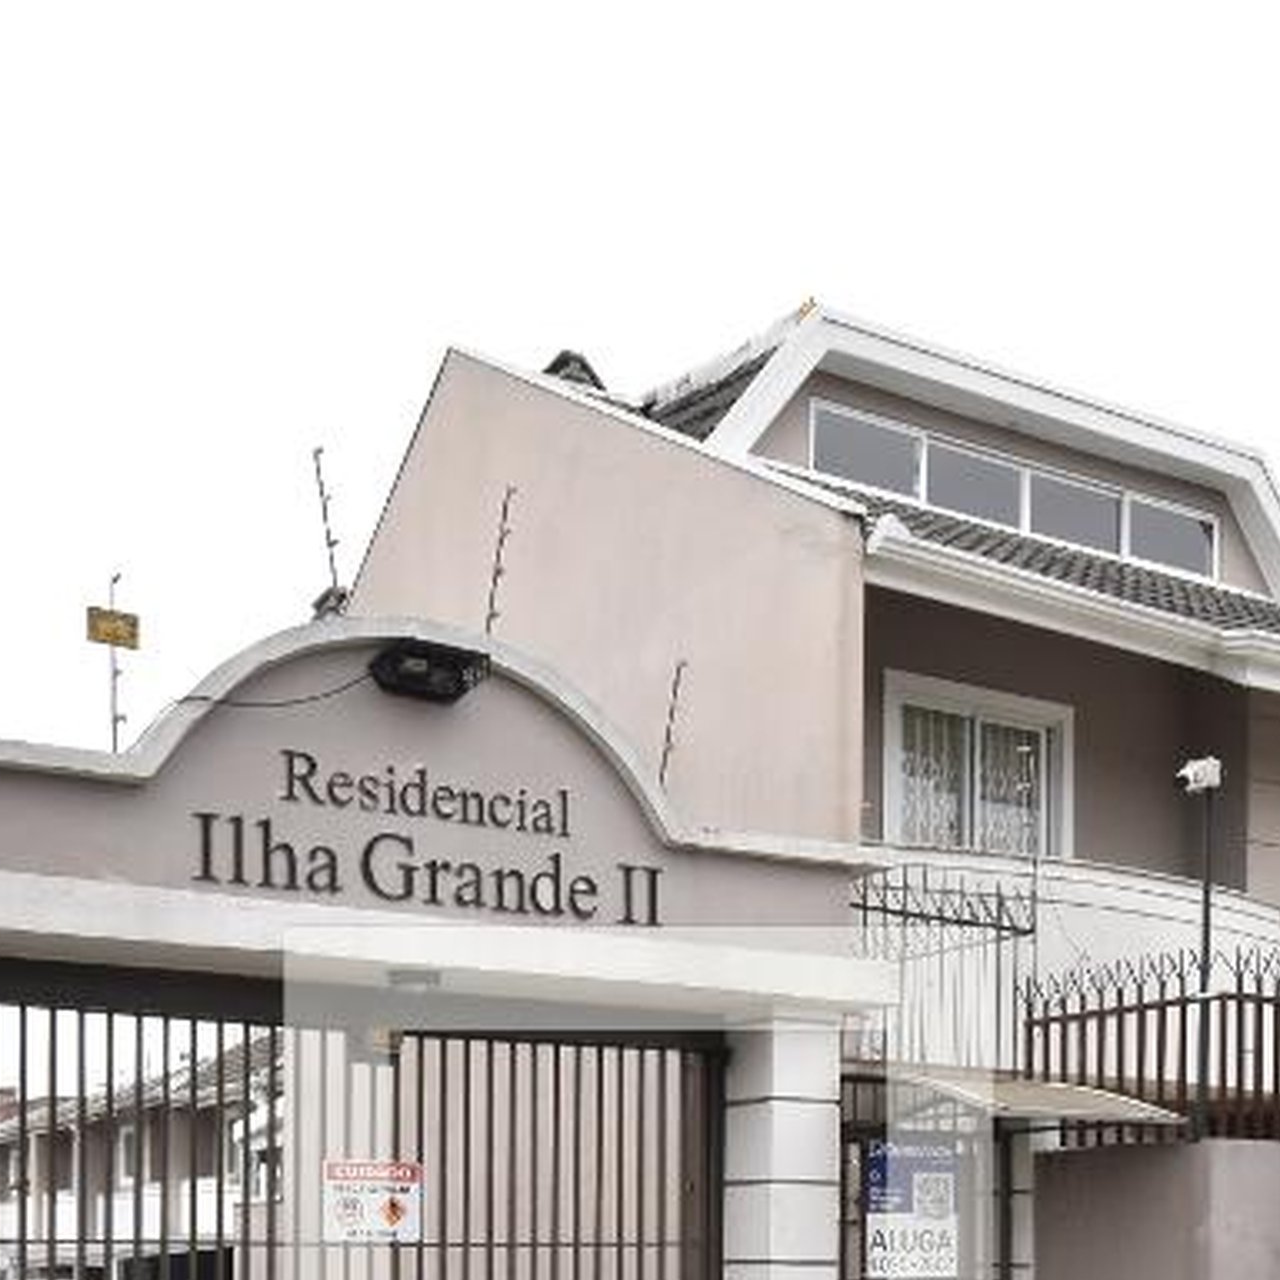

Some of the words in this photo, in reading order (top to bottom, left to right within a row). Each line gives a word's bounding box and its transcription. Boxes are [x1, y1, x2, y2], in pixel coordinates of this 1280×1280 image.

[280, 749, 572, 837] Residencial
[192, 813, 342, 894] Ilha
[361, 832, 599, 920] Grande
[618, 864, 665, 927] II
